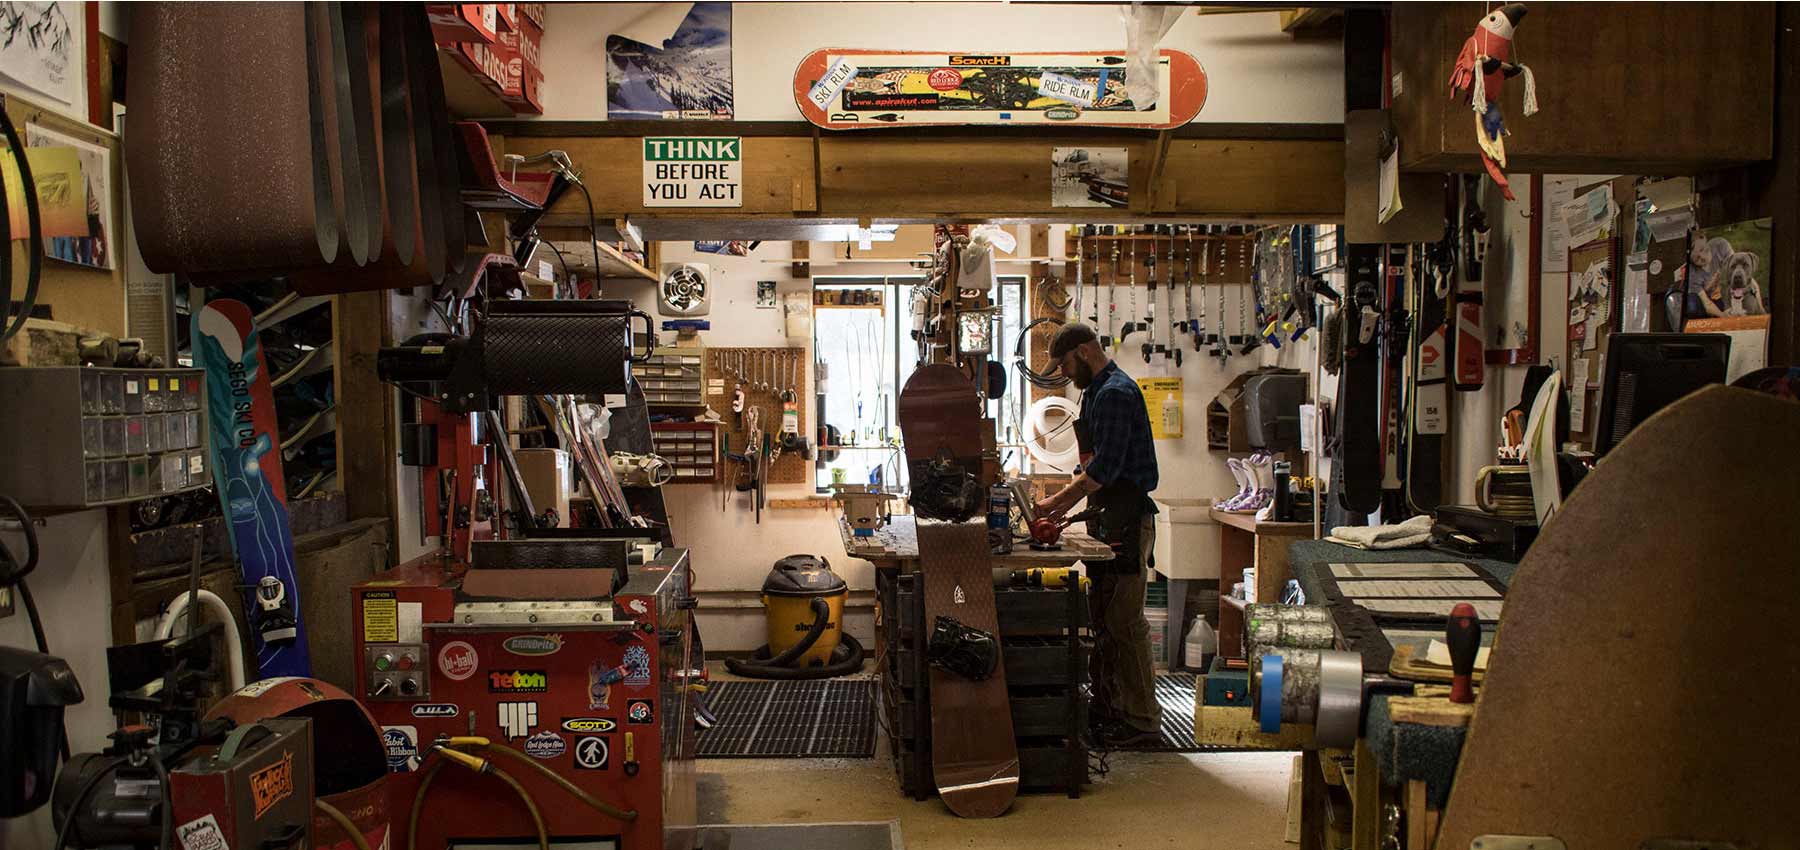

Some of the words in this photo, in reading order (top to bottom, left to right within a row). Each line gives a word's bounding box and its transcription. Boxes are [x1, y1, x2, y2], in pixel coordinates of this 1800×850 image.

[815, 85, 832, 103] SKI
[830, 64, 852, 86] RLM
[1044, 80, 1064, 93] RIDE
[1069, 86, 1090, 100] RLM
[648, 141, 736, 159] THINK
[656, 164, 729, 180] BEFORE
[648, 184, 687, 199] YOU
[699, 184, 738, 199] ACT
[228, 362, 248, 397] SEGO
[235, 402, 253, 424] SKI
[239, 429, 257, 446] CO
[390, 747, 415, 756] Ribbon
